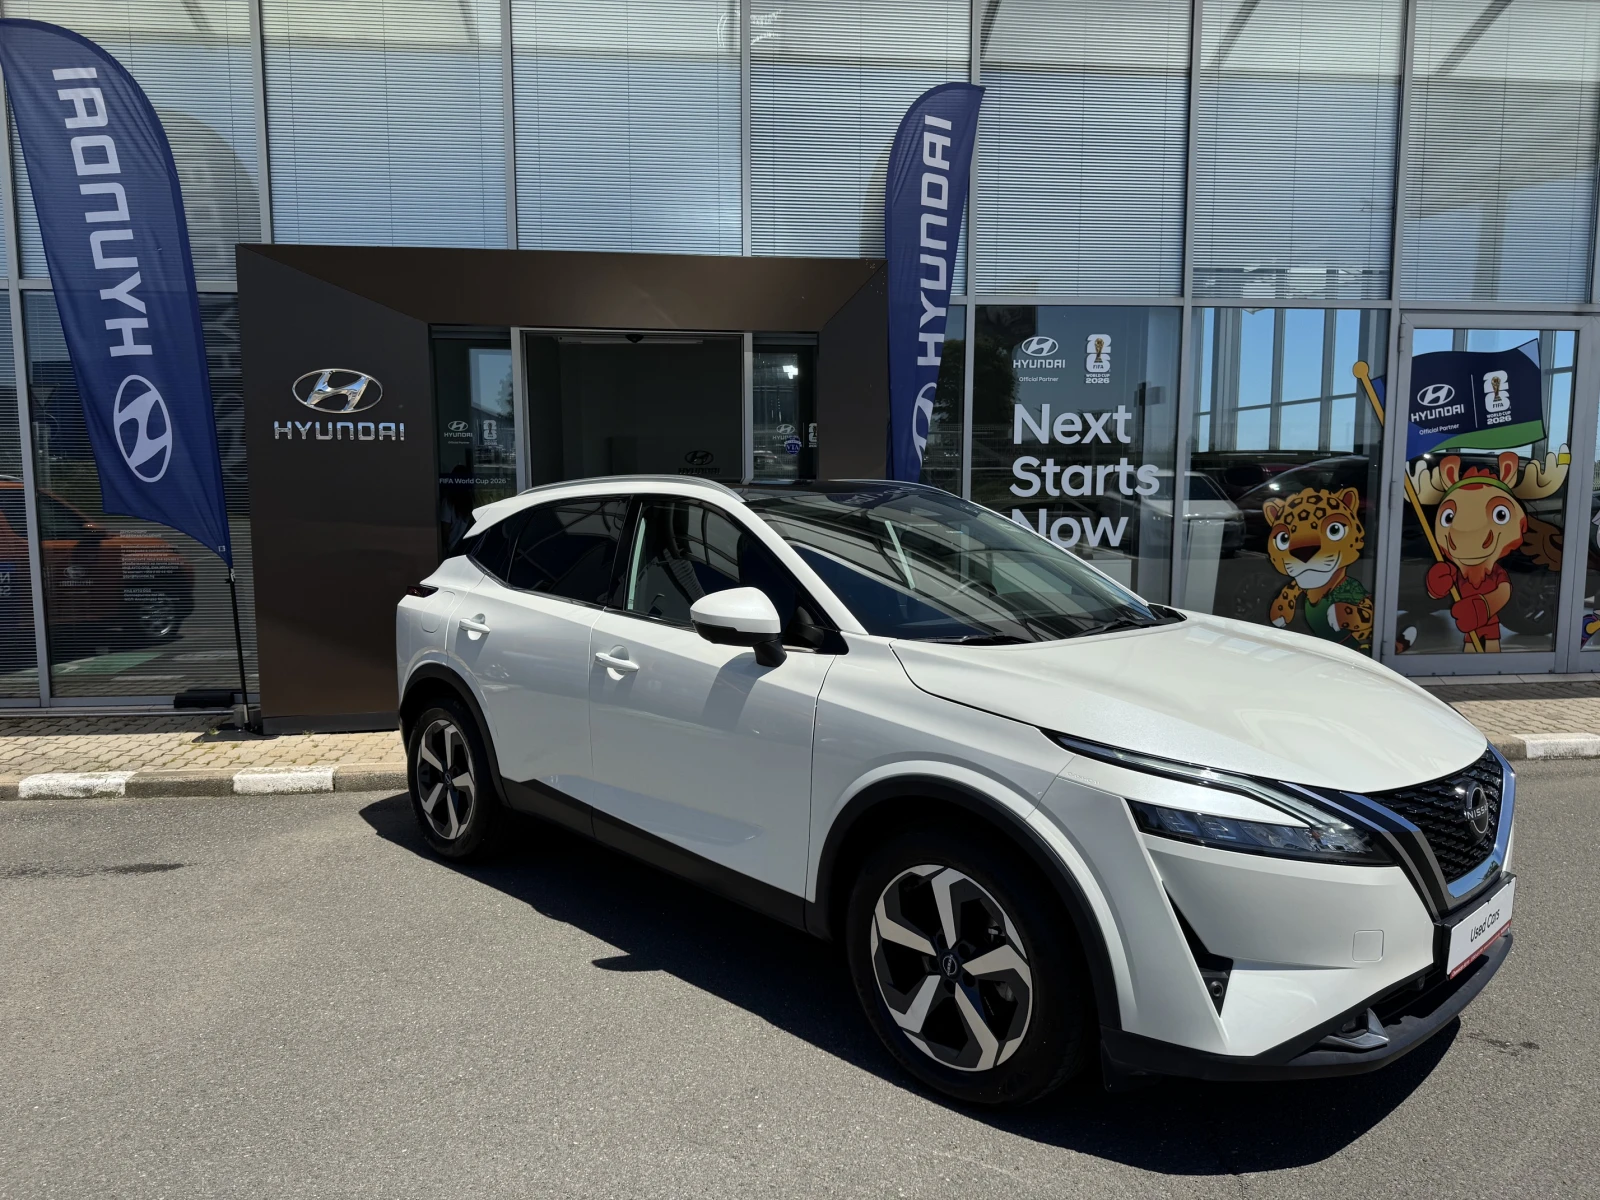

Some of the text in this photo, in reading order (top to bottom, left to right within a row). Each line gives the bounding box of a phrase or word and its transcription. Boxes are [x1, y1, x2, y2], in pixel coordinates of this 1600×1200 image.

[917, 114, 952, 366] HYUNDAI
[1013, 359, 1065, 369] HYUNDAI
[1014, 403, 1132, 445] Next
[1411, 404, 1465, 423] HYUNDAI
[1487, 416, 1512, 425] 2026
[273, 421, 405, 442] HYUNDAI
[1419, 424, 1460, 435] Official Partner
[1010, 455, 1160, 497] Starts
[1012, 508, 1129, 549] Now
[1470, 921, 1486, 943] Used
[1486, 909, 1500, 928] Cars
